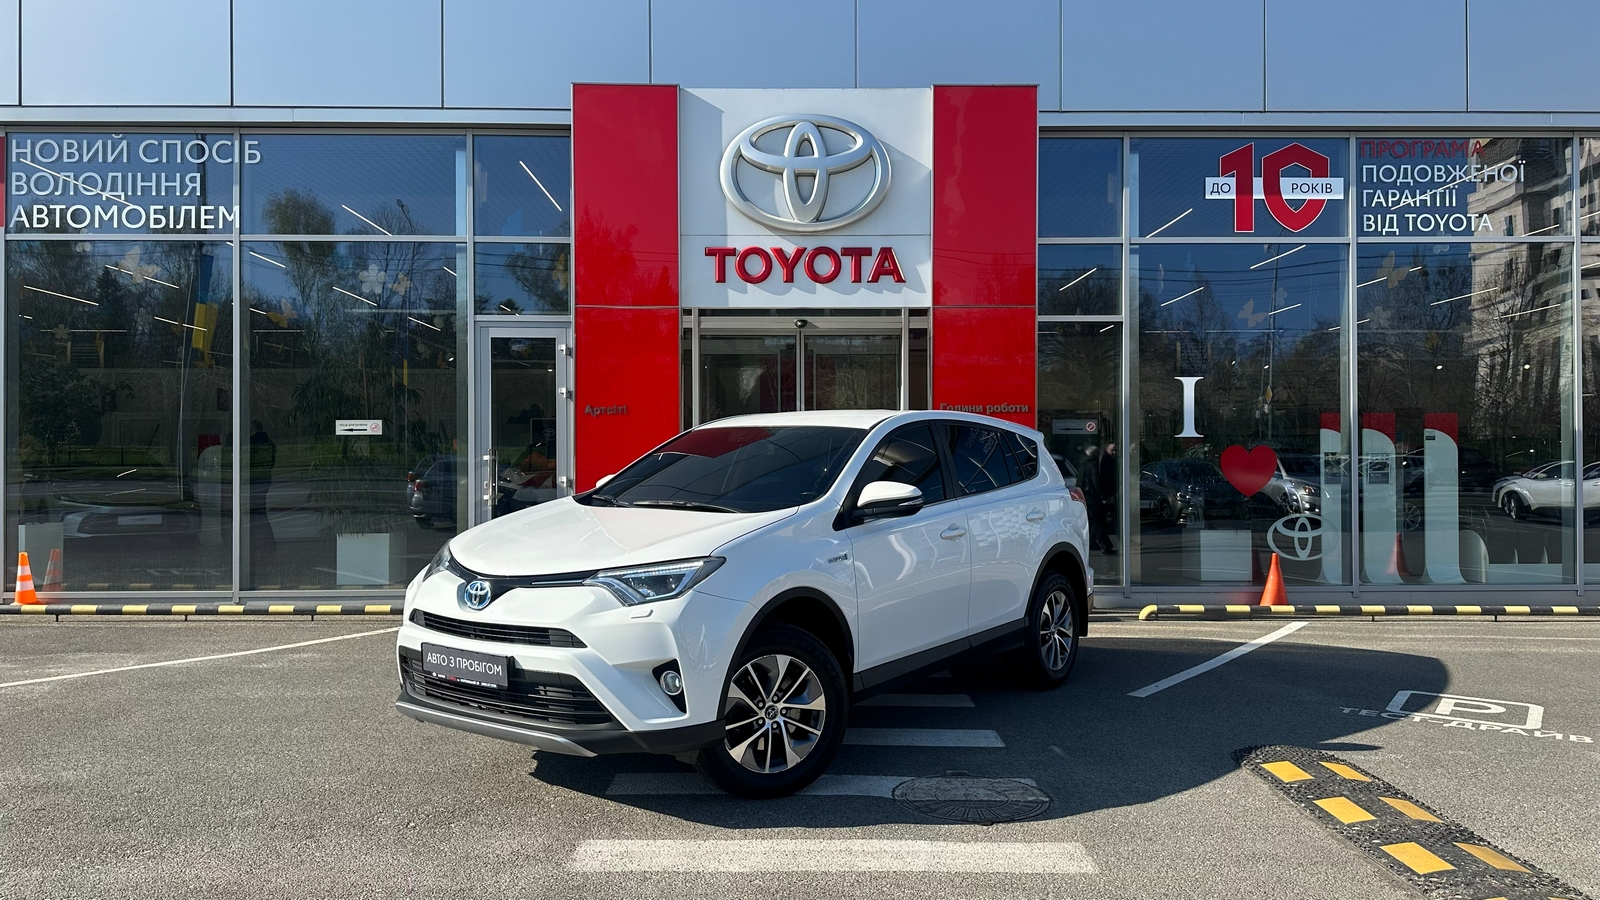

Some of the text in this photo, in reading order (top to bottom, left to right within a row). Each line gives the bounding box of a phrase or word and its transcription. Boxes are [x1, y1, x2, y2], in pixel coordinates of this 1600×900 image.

[12, 134, 261, 164] НОВИЙ СПОСІБ
[1360, 140, 1486, 158] ПРОГРАМА
[1362, 160, 1526, 186] ПОДОВЖЕНОЇ
[11, 172, 201, 200] ВОЛОДІННЯ
[1210, 142, 1333, 233] ДО 10 РОКІВ
[1362, 186, 1456, 207] ГАРАНТІЇ
[9, 205, 239, 229] АВТОМОБІЛЕМ
[1363, 213, 1493, 235] ВІД TOYOTA
[705, 246, 906, 284] TOYOTA
[986, 402, 1029, 414] роботи
[1174, 376, 1204, 437] I
[427, 652, 448, 666] АВТО
[456, 657, 502, 676] ПРОБІГОМ
[1435, 698, 1507, 715] P
[1338, 706, 1594, 743] ТЕСТ-ДРАЙВ
